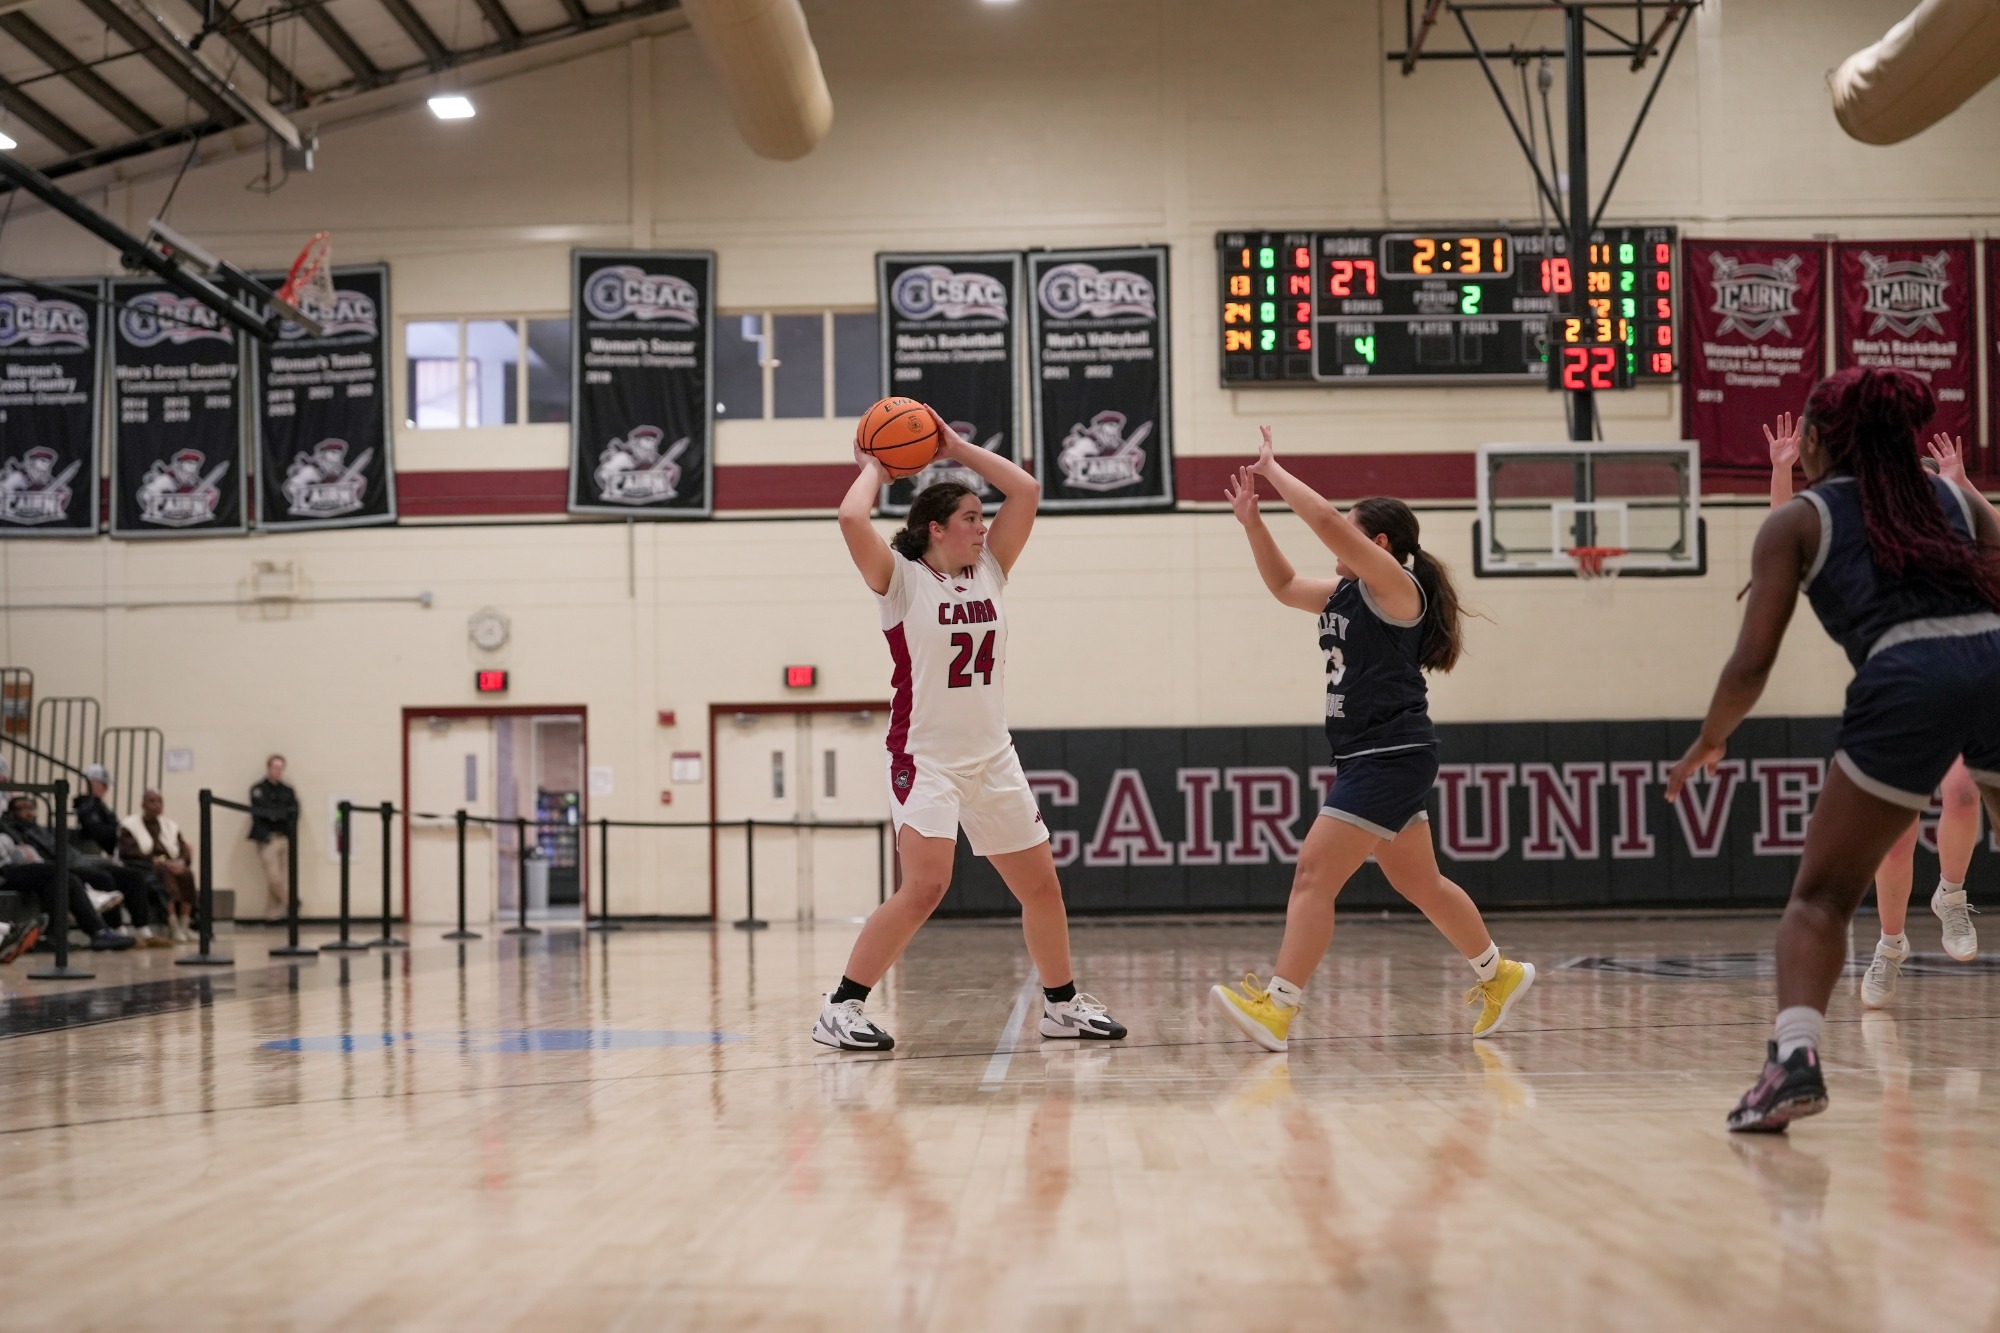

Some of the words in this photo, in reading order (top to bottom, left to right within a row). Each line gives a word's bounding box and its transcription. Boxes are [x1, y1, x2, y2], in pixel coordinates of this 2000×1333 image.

[1322, 237, 1372, 256] HOME
[1412, 238, 1503, 275] 2:31
[1590, 244, 1610, 264] 11
[1619, 243, 1634, 264] 0
[1655, 243, 1669, 264] 0
[1242, 248, 1250, 269] 1
[1259, 247, 1274, 269] 0
[1295, 247, 1310, 269] 6
[1230, 275, 1250, 296] 13
[1266, 275, 1275, 296] 1
[1290, 275, 1311, 295] 14
[1330, 260, 1376, 296] 27
[1541, 257, 1573, 293] 18
[1620, 271, 1634, 292] 2
[1656, 271, 1670, 291] 0
[622, 279, 695, 308] CSAC
[932, 279, 1004, 304] CSAC
[1078, 279, 1149, 302] CSAC
[1412, 290, 1458, 306] PERIOD
[1461, 285, 1481, 315] 2
[1724, 283, 1786, 312] CAIRN
[1875, 280, 1936, 310] CAIRN
[1224, 302, 1251, 324] 24
[1260, 302, 1275, 323] 0
[1296, 302, 1311, 323] 2
[1341, 299, 1384, 314] BONUS
[1622, 298, 1635, 318] 3
[1657, 298, 1671, 319] 5
[16, 304, 84, 331] CSAC
[1407, 321, 1454, 335] PLAYER
[1459, 321, 1500, 335] FOULS
[1046, 332, 1087, 349] Men's
[1086, 330, 1150, 349] Volleyball
[1336, 322, 1375, 336] FOULS
[1658, 325, 1672, 346] 0
[590, 337, 650, 354] Women's
[650, 337, 696, 355] Soccer
[896, 333, 937, 350] Men's
[938, 331, 1005, 350] Basketball
[1224, 329, 1252, 351] 34
[1261, 329, 1276, 351] 2
[1297, 329, 1312, 350] 5
[1354, 336, 1375, 364] 4
[1702, 341, 1759, 359] Women's
[1760, 344, 1805, 360] Soccer
[1852, 339, 1890, 354] Men's
[1891, 340, 1957, 356] Basketball
[270, 354, 329, 372] Women's
[330, 351, 372, 370] Tennis
[584, 352, 640, 368] Conference
[640, 353, 697, 370] Champions
[894, 349, 950, 364] Conference
[950, 348, 1007, 364] Champions
[1042, 348, 1098, 362] Conference
[1099, 347, 1154, 362] Champions
[1653, 353, 1672, 373] 13
[6, 363, 63, 379] Women's
[115, 364, 152, 380] Men's
[153, 363, 189, 379] Cross
[190, 362, 239, 379] Country
[1563, 347, 1616, 389] 22
[0, 379, 27, 393] ross
[29, 376, 77, 394] Country
[939, 598, 997, 625] CAIRN
[948, 630, 996, 689] 24
